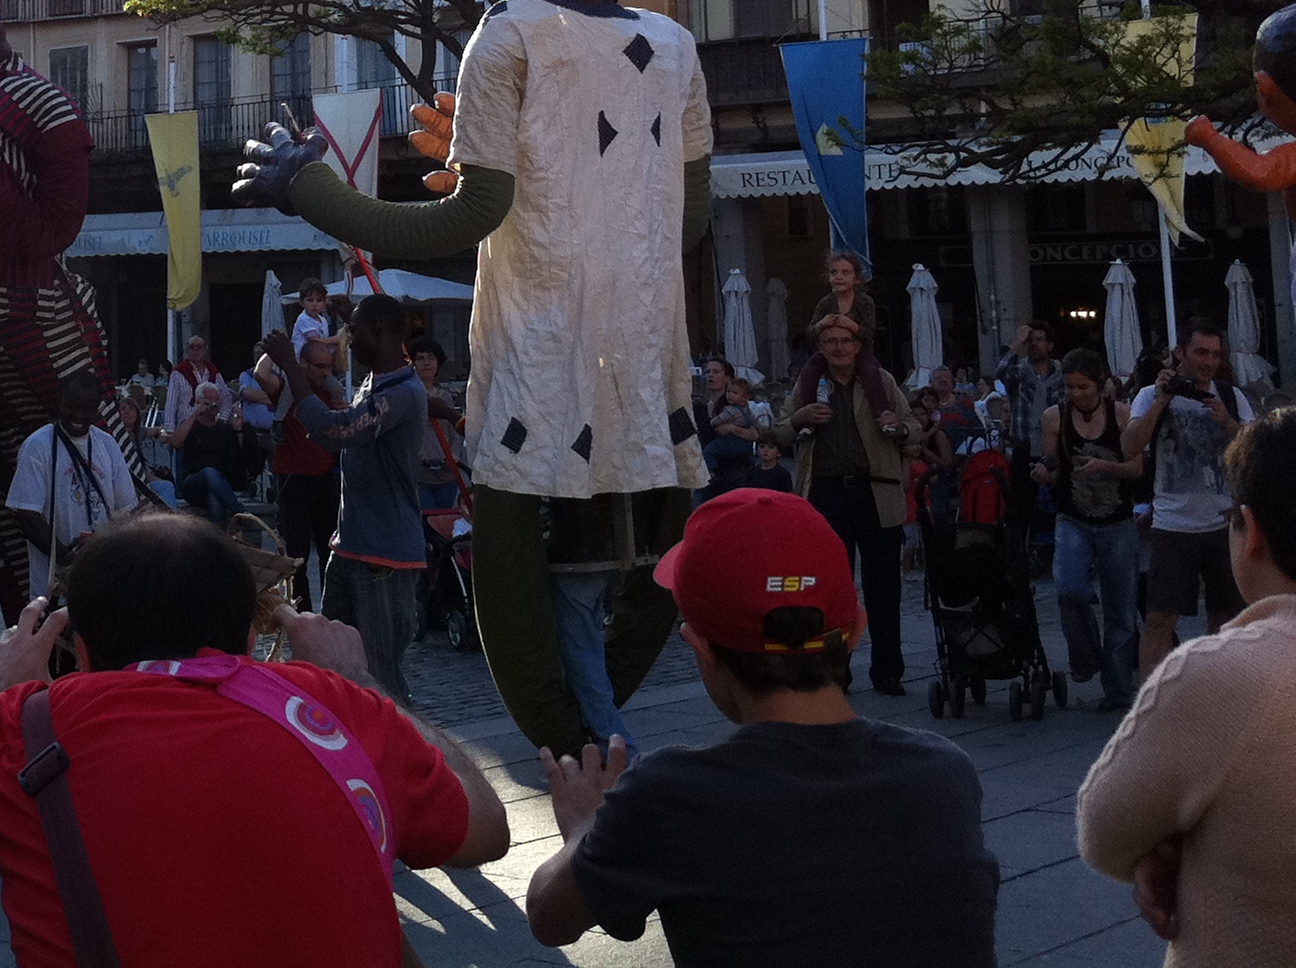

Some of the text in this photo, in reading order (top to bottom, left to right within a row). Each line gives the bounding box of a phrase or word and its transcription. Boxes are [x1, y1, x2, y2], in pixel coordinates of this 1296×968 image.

[740, 162, 900, 188] RESTAUNTE
[205, 229, 272, 247] ARROUSEL
[1028, 243, 1157, 262] ONCEPCIO
[765, 575, 817, 592] ESP
